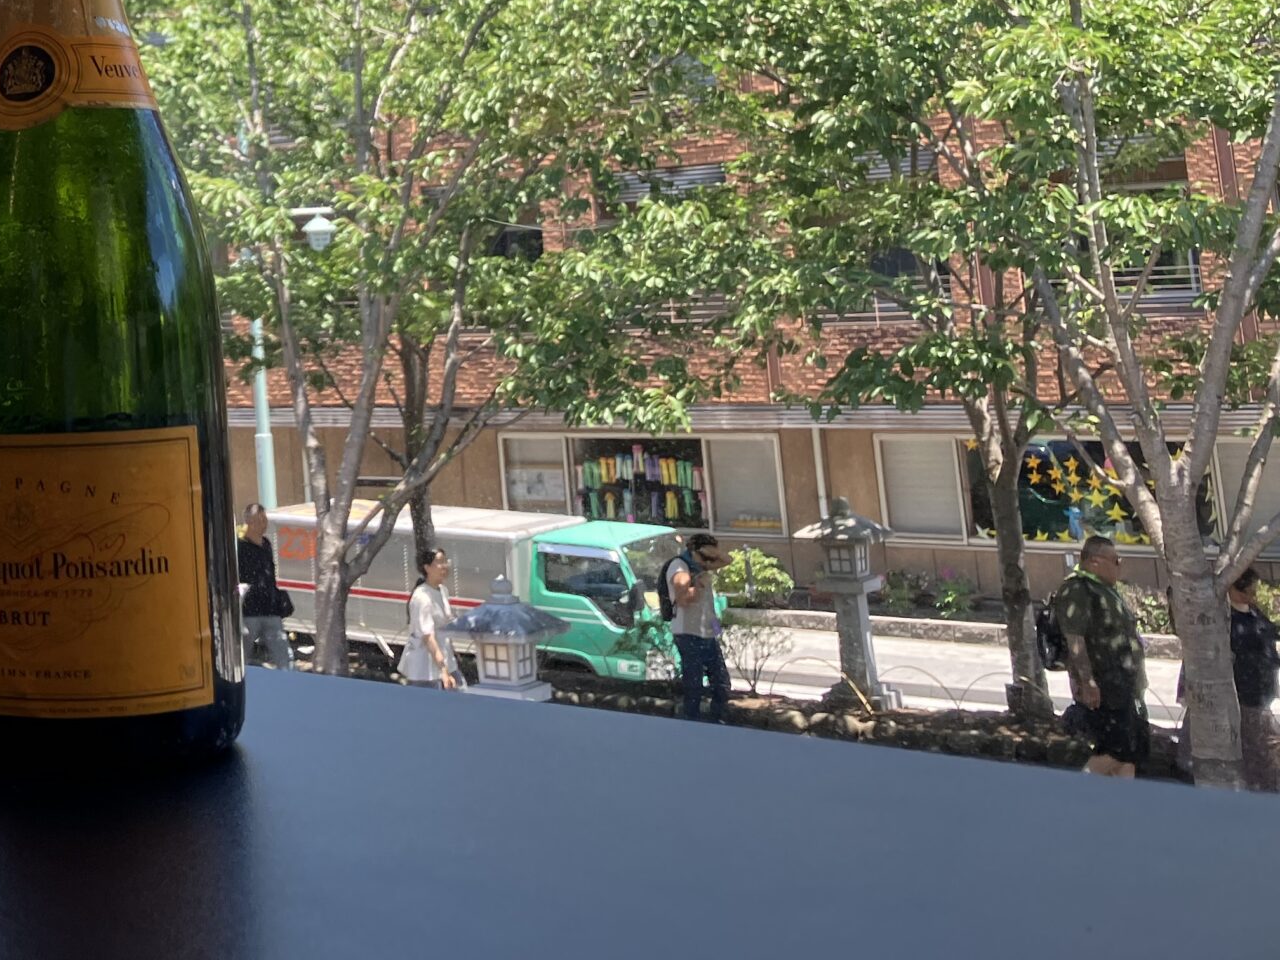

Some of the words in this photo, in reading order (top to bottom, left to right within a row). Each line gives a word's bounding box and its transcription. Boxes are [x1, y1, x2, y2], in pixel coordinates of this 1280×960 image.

[89, 55, 140, 79] Veuve
[52, 549, 169, 580] Ponsardin
[34, 667, 92, 681] FRANCE
